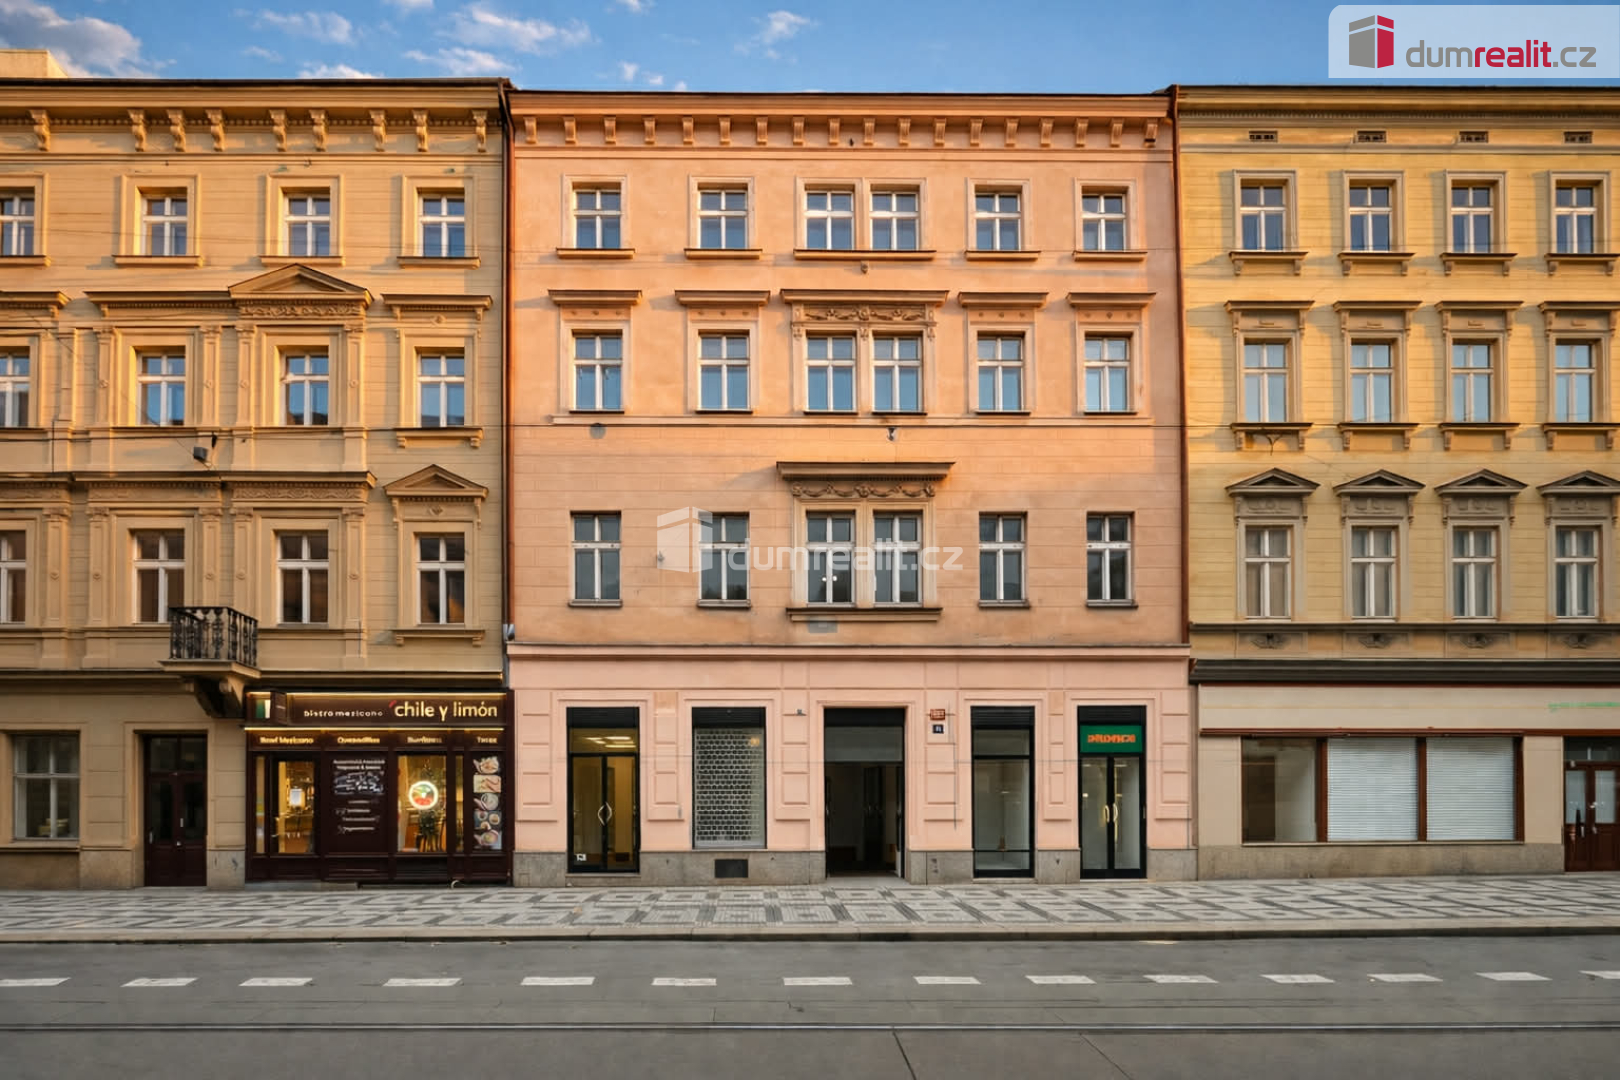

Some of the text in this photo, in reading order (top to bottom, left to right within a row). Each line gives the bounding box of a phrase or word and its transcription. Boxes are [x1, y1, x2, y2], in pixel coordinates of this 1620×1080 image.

[394, 701, 498, 722] chile y limón
